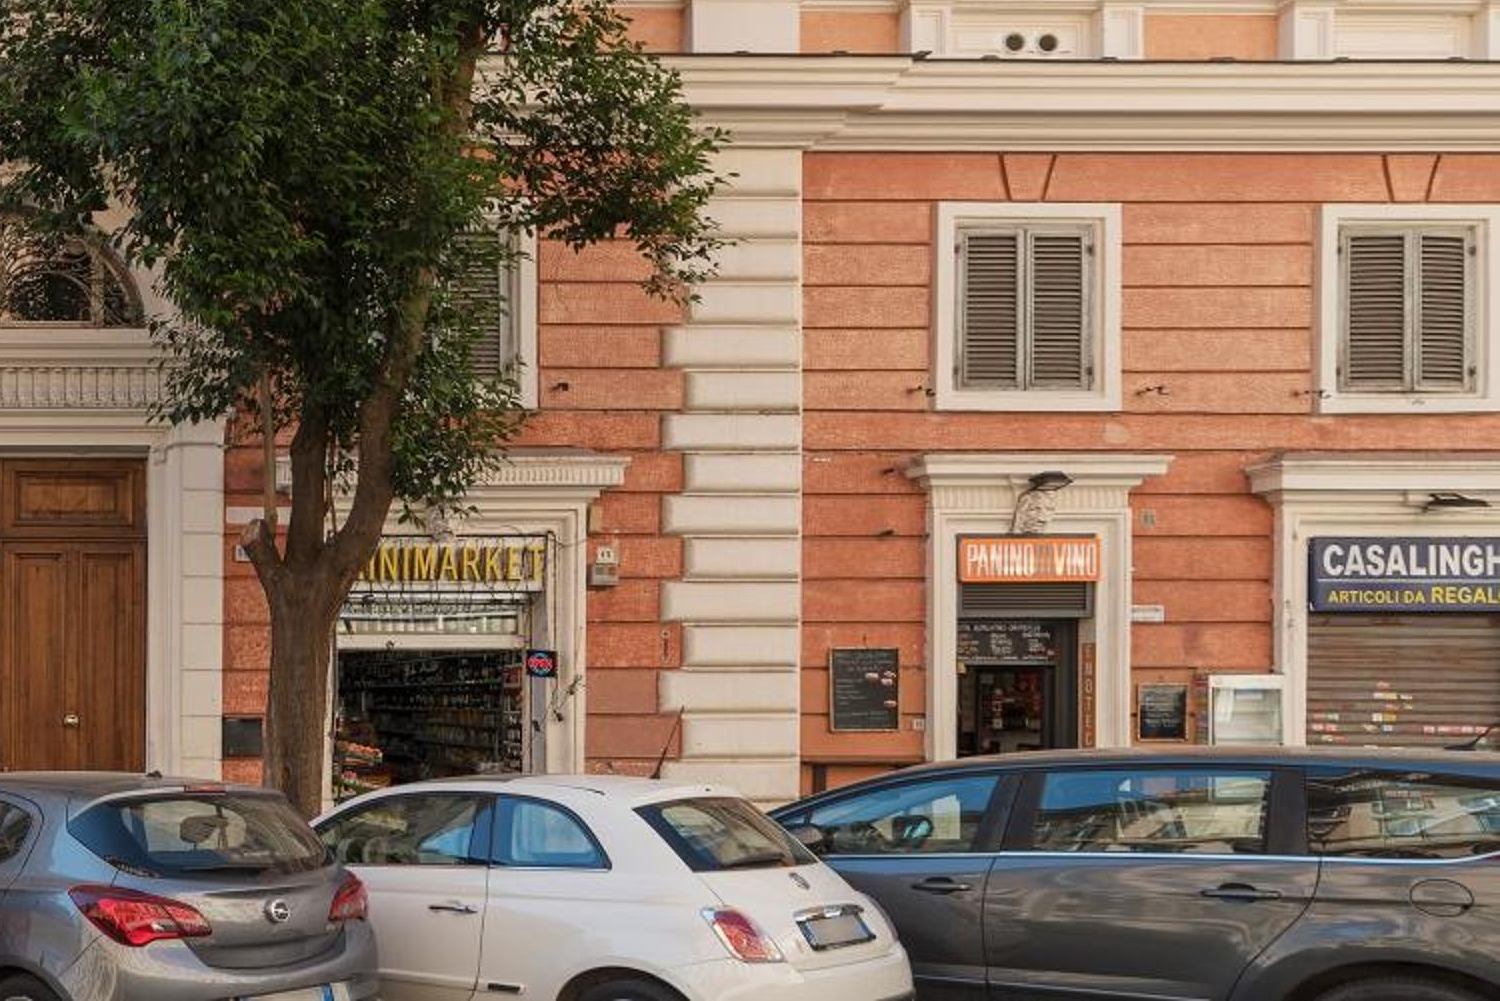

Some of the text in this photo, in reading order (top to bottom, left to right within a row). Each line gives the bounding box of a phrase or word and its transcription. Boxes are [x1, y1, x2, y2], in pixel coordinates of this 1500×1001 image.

[357, 546, 547, 583] INIMARKET
[966, 543, 1035, 577] PANINO
[1053, 543, 1097, 577] VINO
[1328, 586, 1500, 605] ARTICOLI DA REGAL
